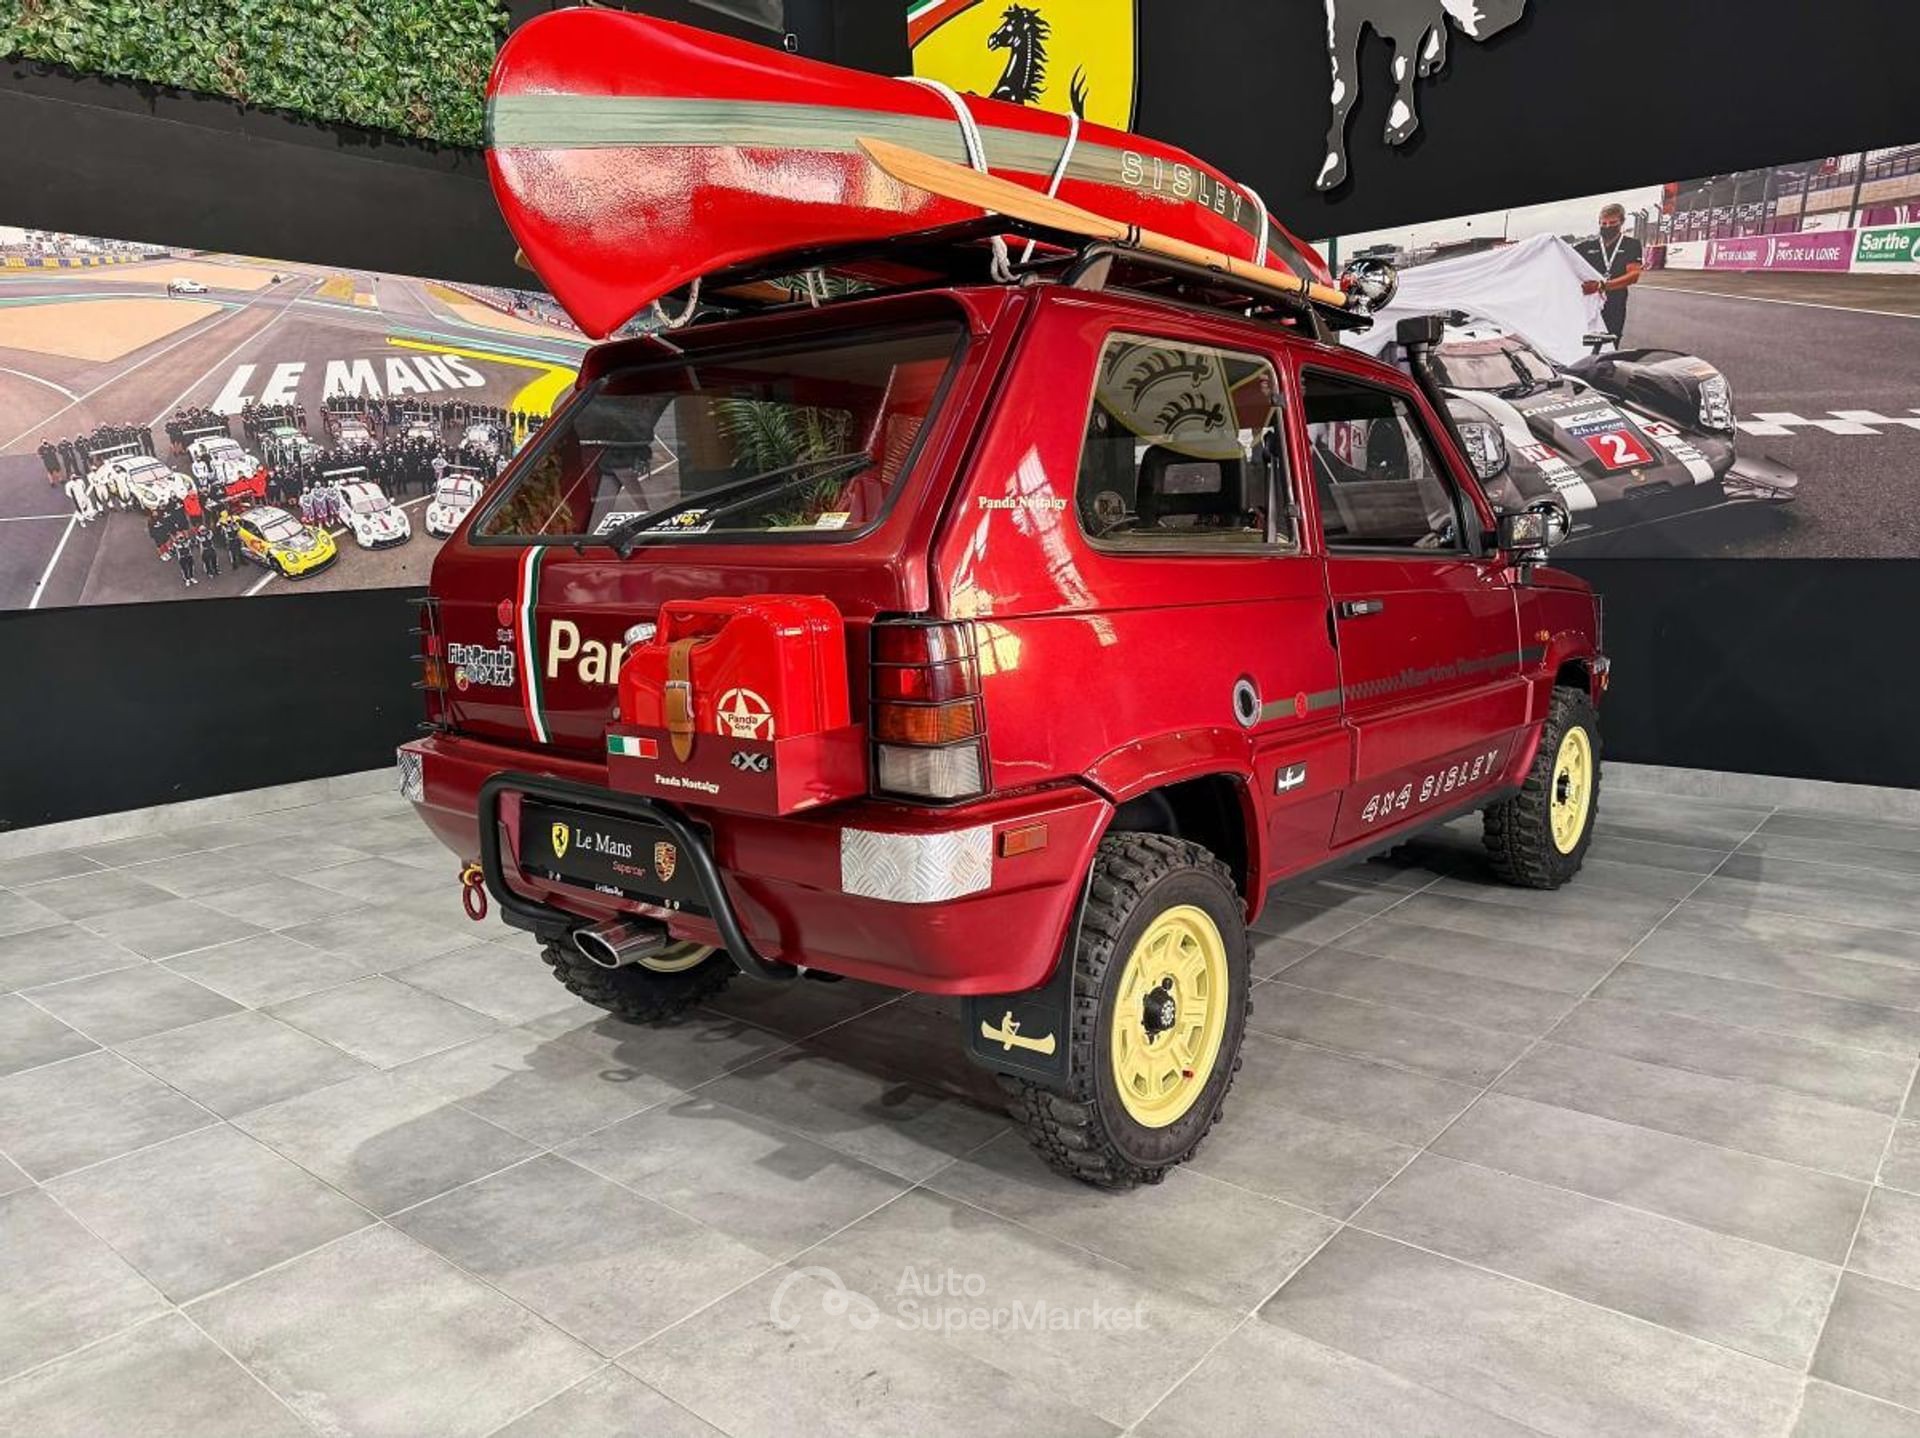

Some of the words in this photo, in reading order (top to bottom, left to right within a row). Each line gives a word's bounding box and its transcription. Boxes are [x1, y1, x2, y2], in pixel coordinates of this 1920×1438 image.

[1121, 150, 1242, 222] SISLEY
[1861, 232, 1910, 251] Sarthe
[210, 361, 307, 416] LE
[322, 353, 486, 402] MANS
[1600, 434, 1640, 464] 2
[977, 495, 1016, 510] Panda
[727, 712, 759, 726] Panda
[654, 773, 682, 788] Panda
[682, 776, 720, 795] Nostalgy
[1419, 750, 1499, 803] SISLEY
[575, 828, 592, 850] Le
[594, 831, 632, 859] Mans
